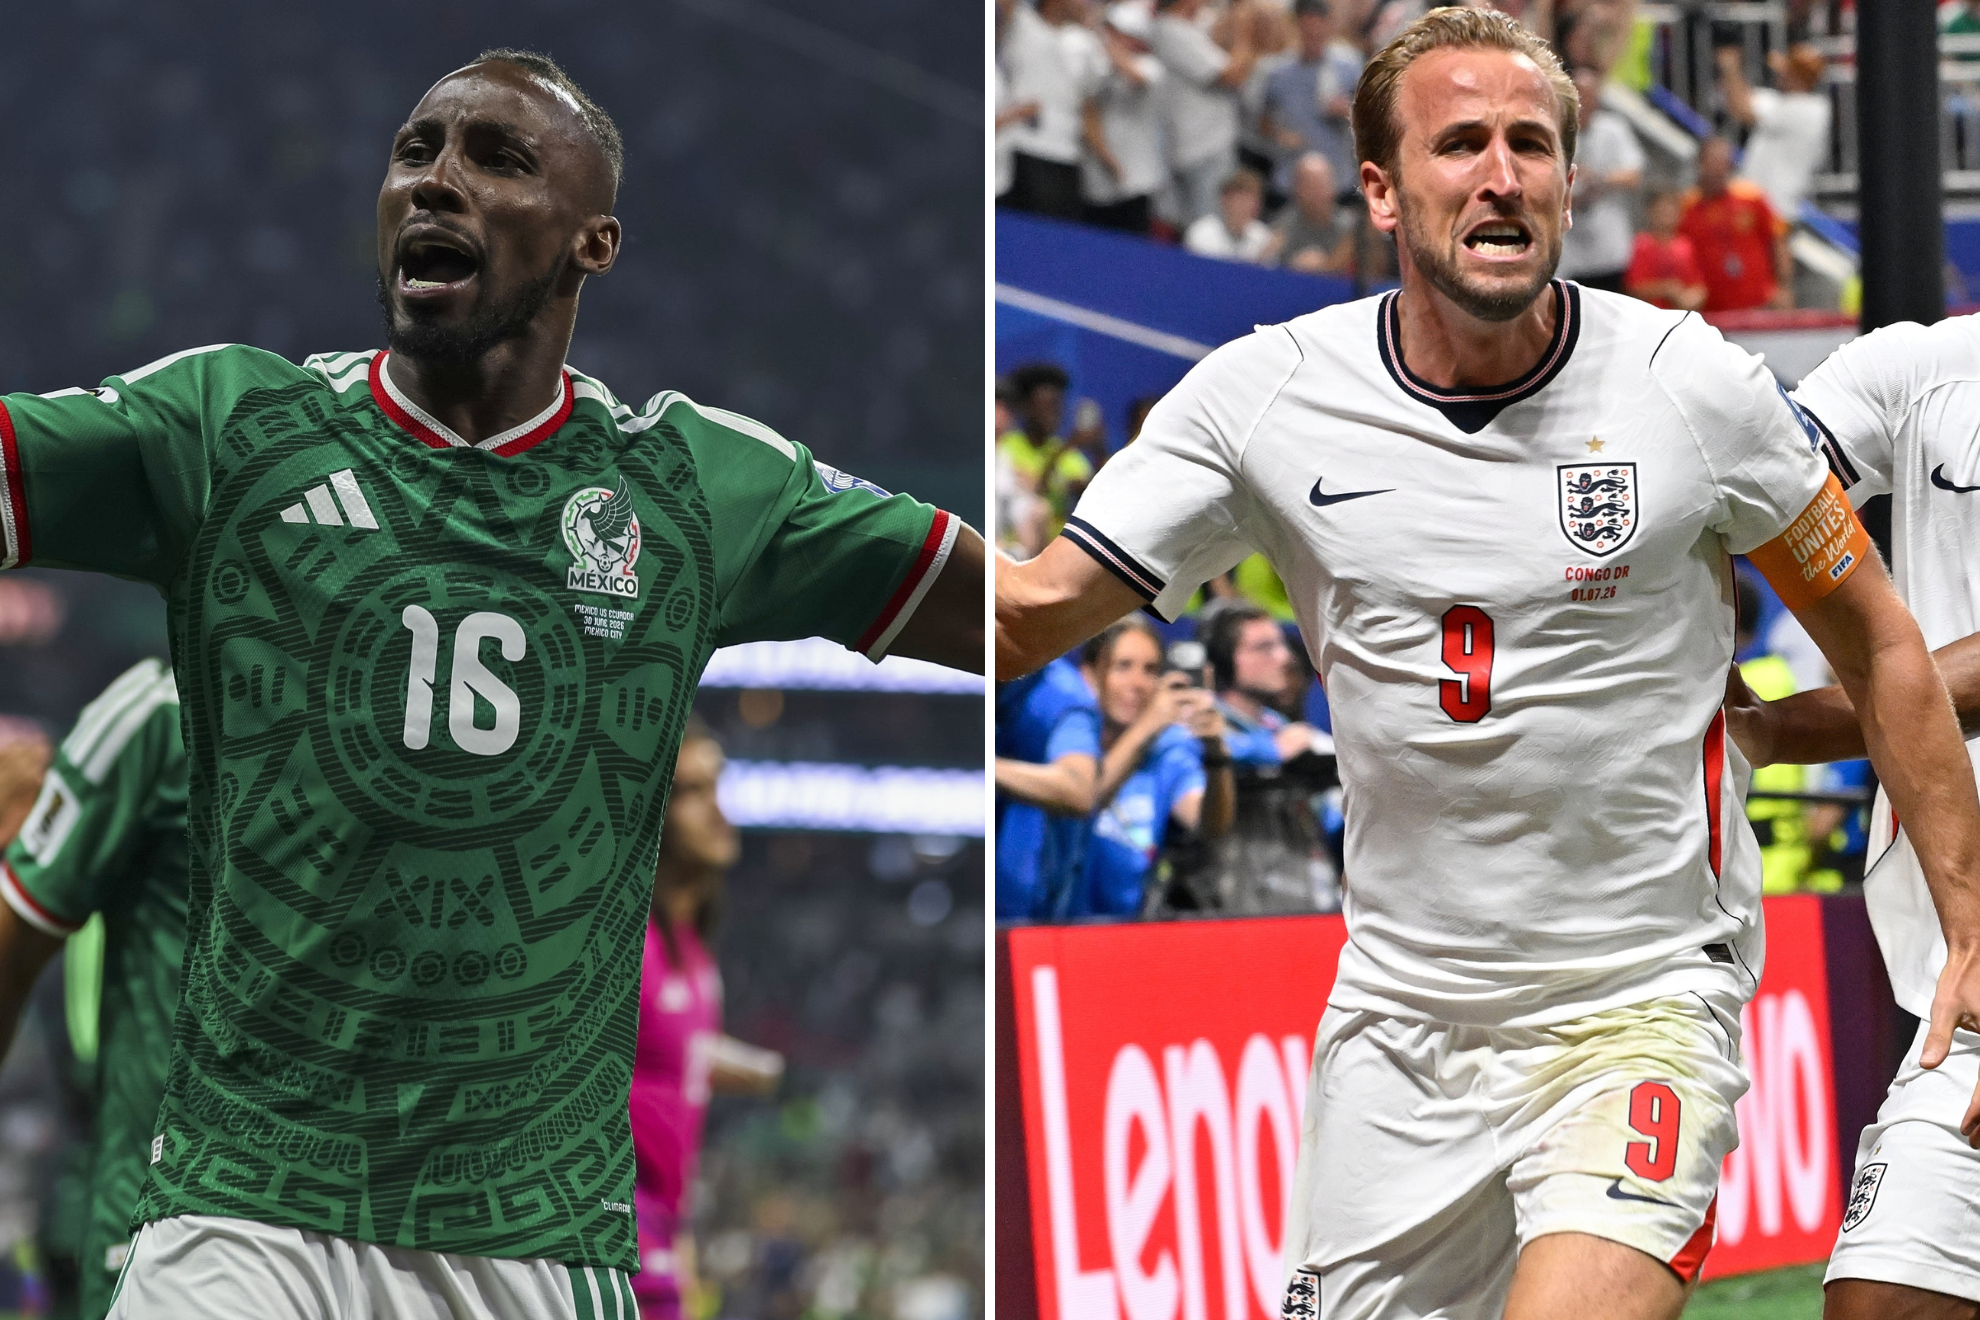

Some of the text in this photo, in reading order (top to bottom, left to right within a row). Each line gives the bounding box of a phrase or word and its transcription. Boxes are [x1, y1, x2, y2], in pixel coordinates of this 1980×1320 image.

[1784, 487, 1836, 548] FOOTBALL
[1791, 500, 1846, 564] UNITES
[1800, 515, 1856, 582] the World
[1831, 555, 1853, 578] FIFA
[569, 569, 636, 594] MÉXICO
[1565, 565, 1630, 582] CONGO DR
[1571, 586, 1617, 601] 01.07.26
[583, 615, 624, 630] 30 JUNE 2026
[609, 610, 634, 620] ECUADOR
[610, 630, 622, 639] CITY
[402, 604, 526, 756] 16
[1438, 604, 1495, 723] 9
[1031, 963, 1310, 1320] Leno
[1624, 1081, 1681, 1183] 9
